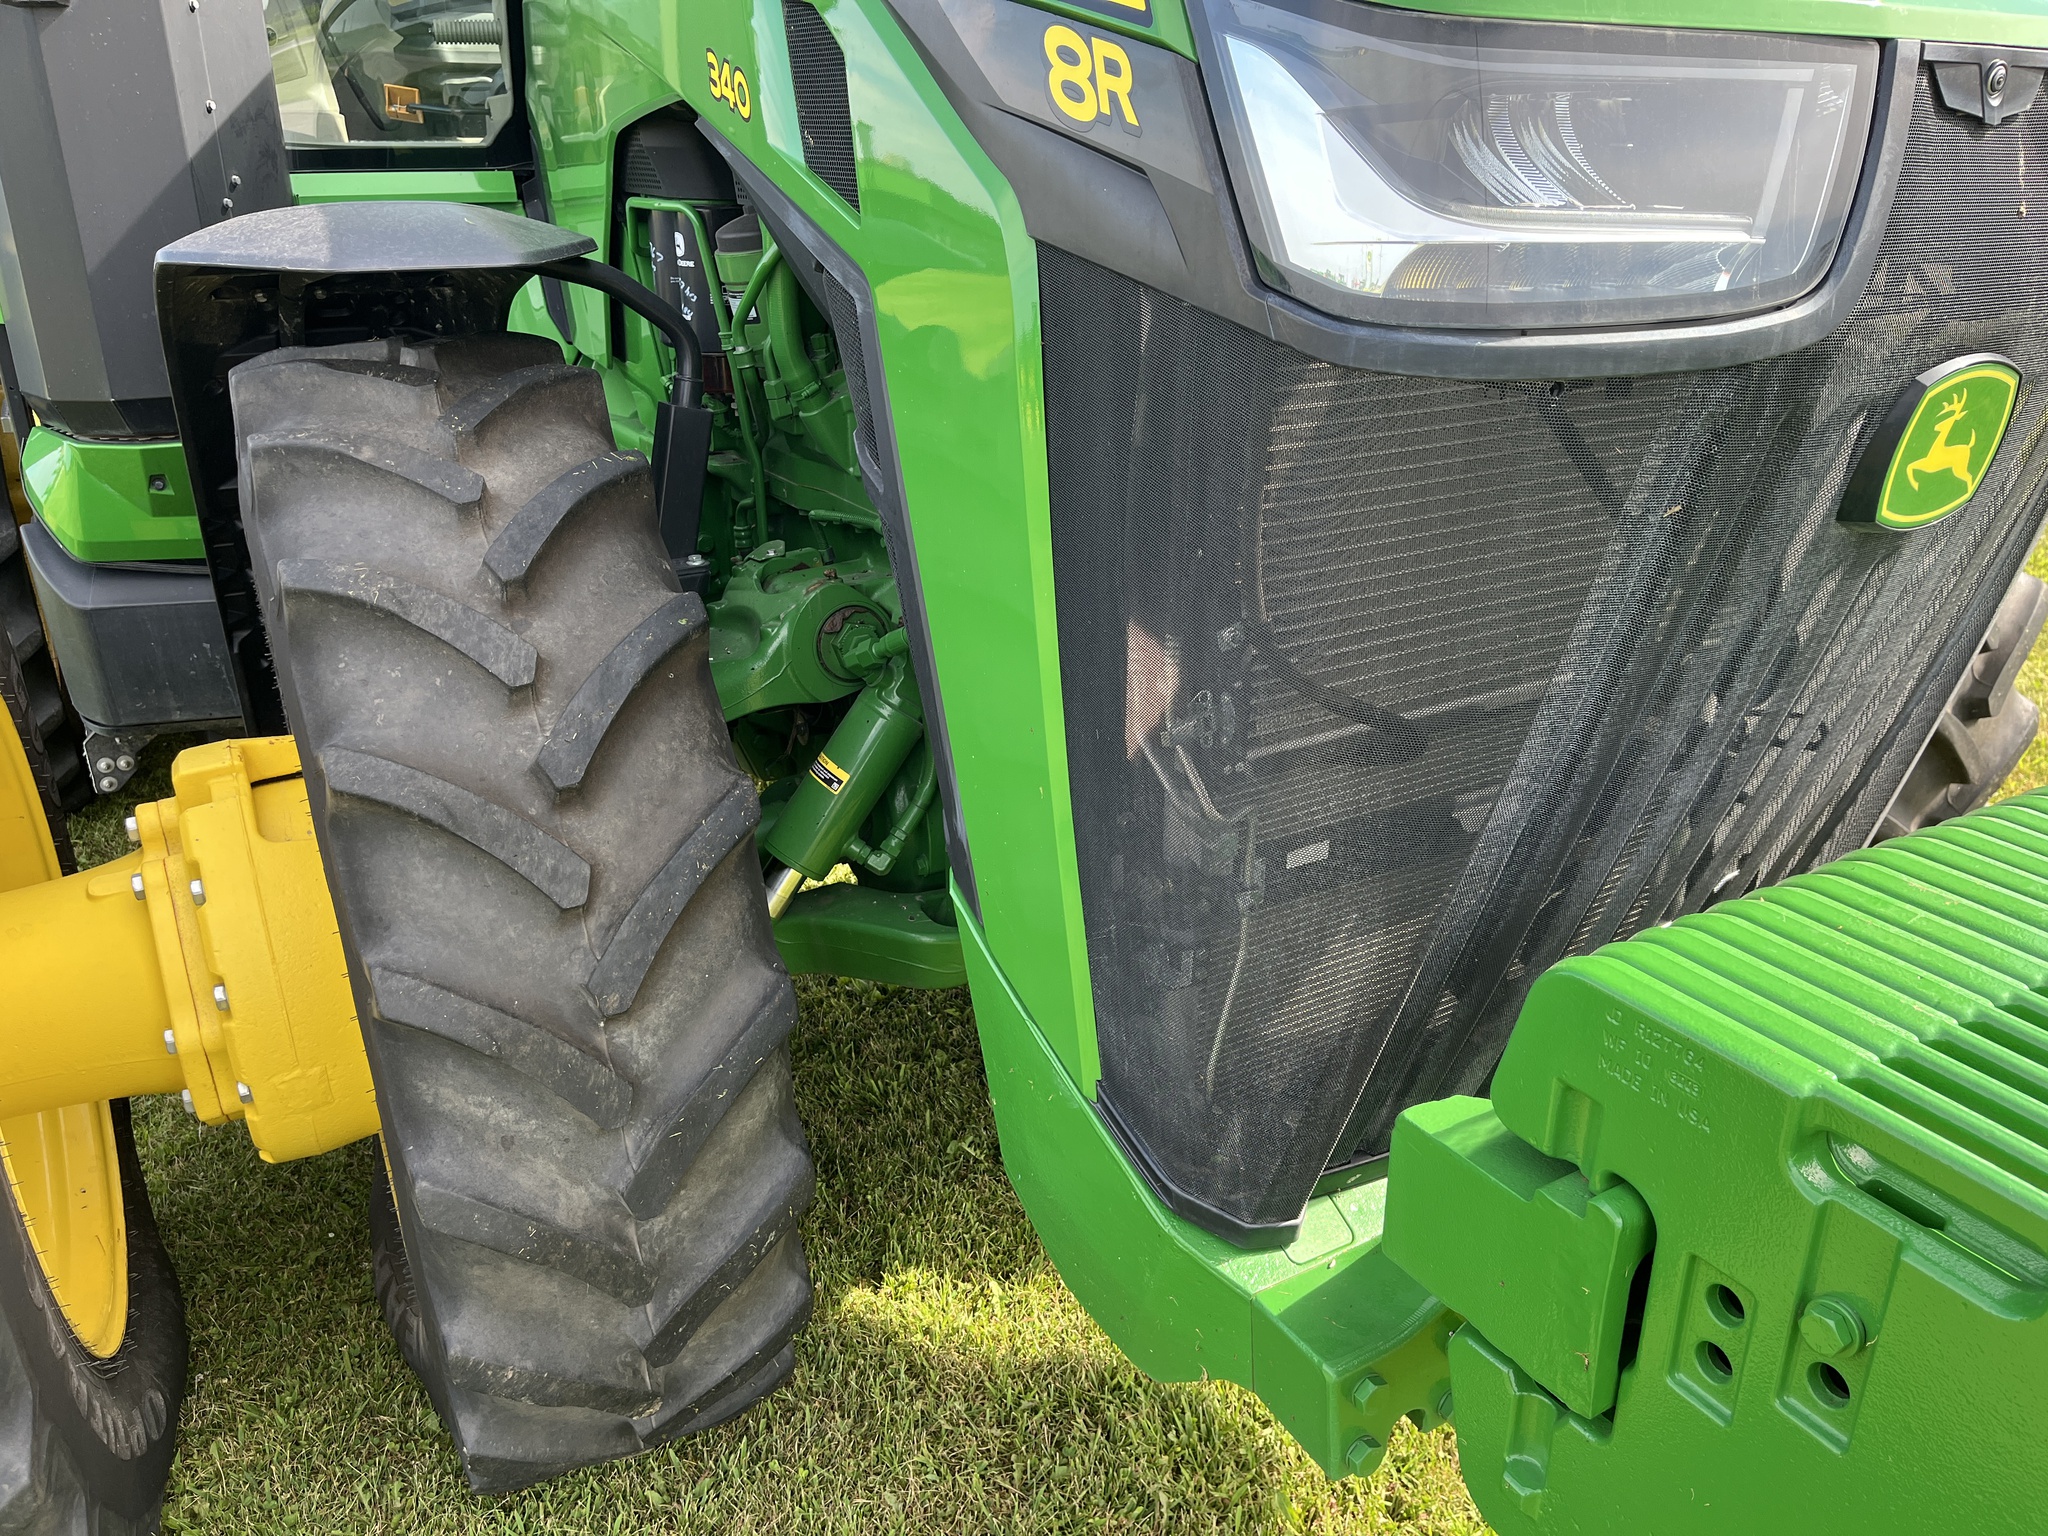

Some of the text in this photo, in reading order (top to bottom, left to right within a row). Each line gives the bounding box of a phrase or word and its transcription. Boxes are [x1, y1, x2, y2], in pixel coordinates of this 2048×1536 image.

[706, 48, 751, 122] 340
[1044, 25, 1140, 127] 8R
[1598, 1054, 1710, 1134] MADE IN USA
